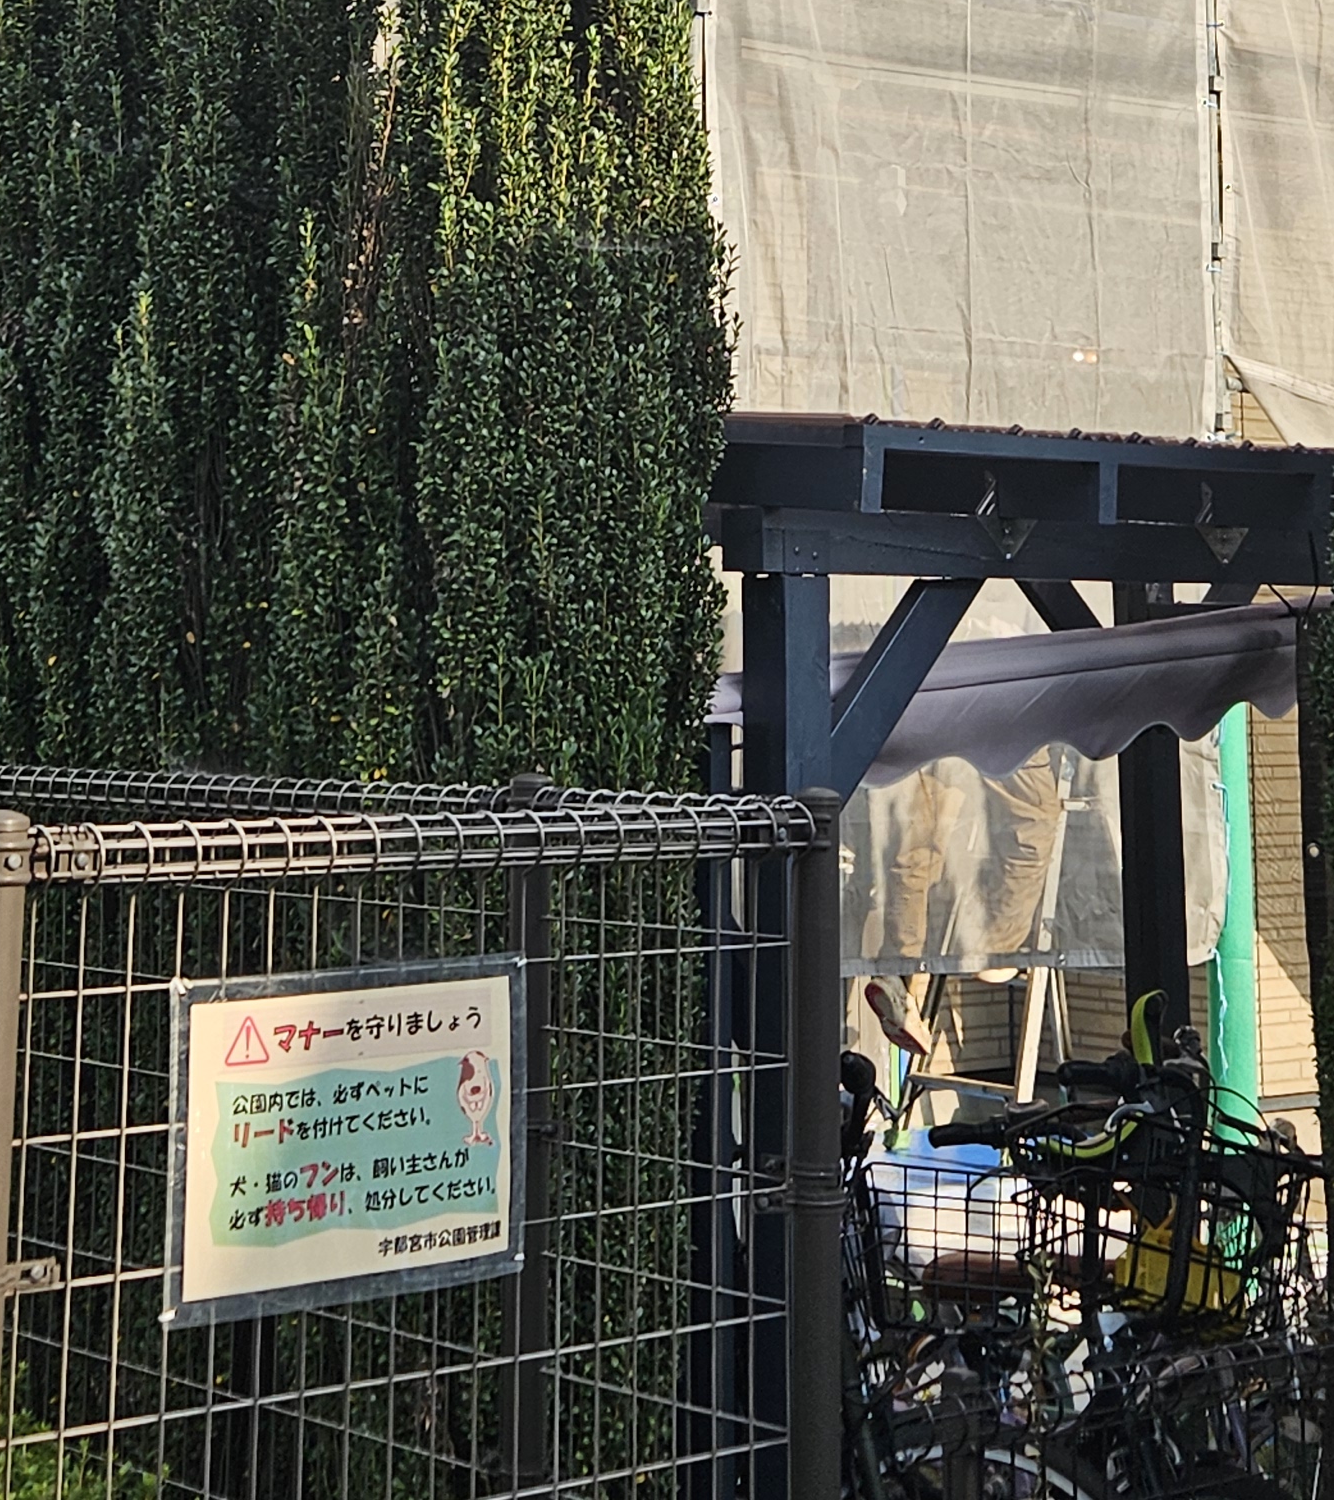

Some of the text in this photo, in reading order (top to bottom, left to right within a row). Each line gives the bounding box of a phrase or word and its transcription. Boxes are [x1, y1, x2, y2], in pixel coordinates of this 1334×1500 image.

[273, 1006, 482, 1053] マナーを守りましょう
[232, 1075, 429, 1116] 公園内では、必ずペットに
[233, 1107, 431, 1148] リードを付けてください。
[377, 1220, 501, 1258] 宇都宮市公園管理課
